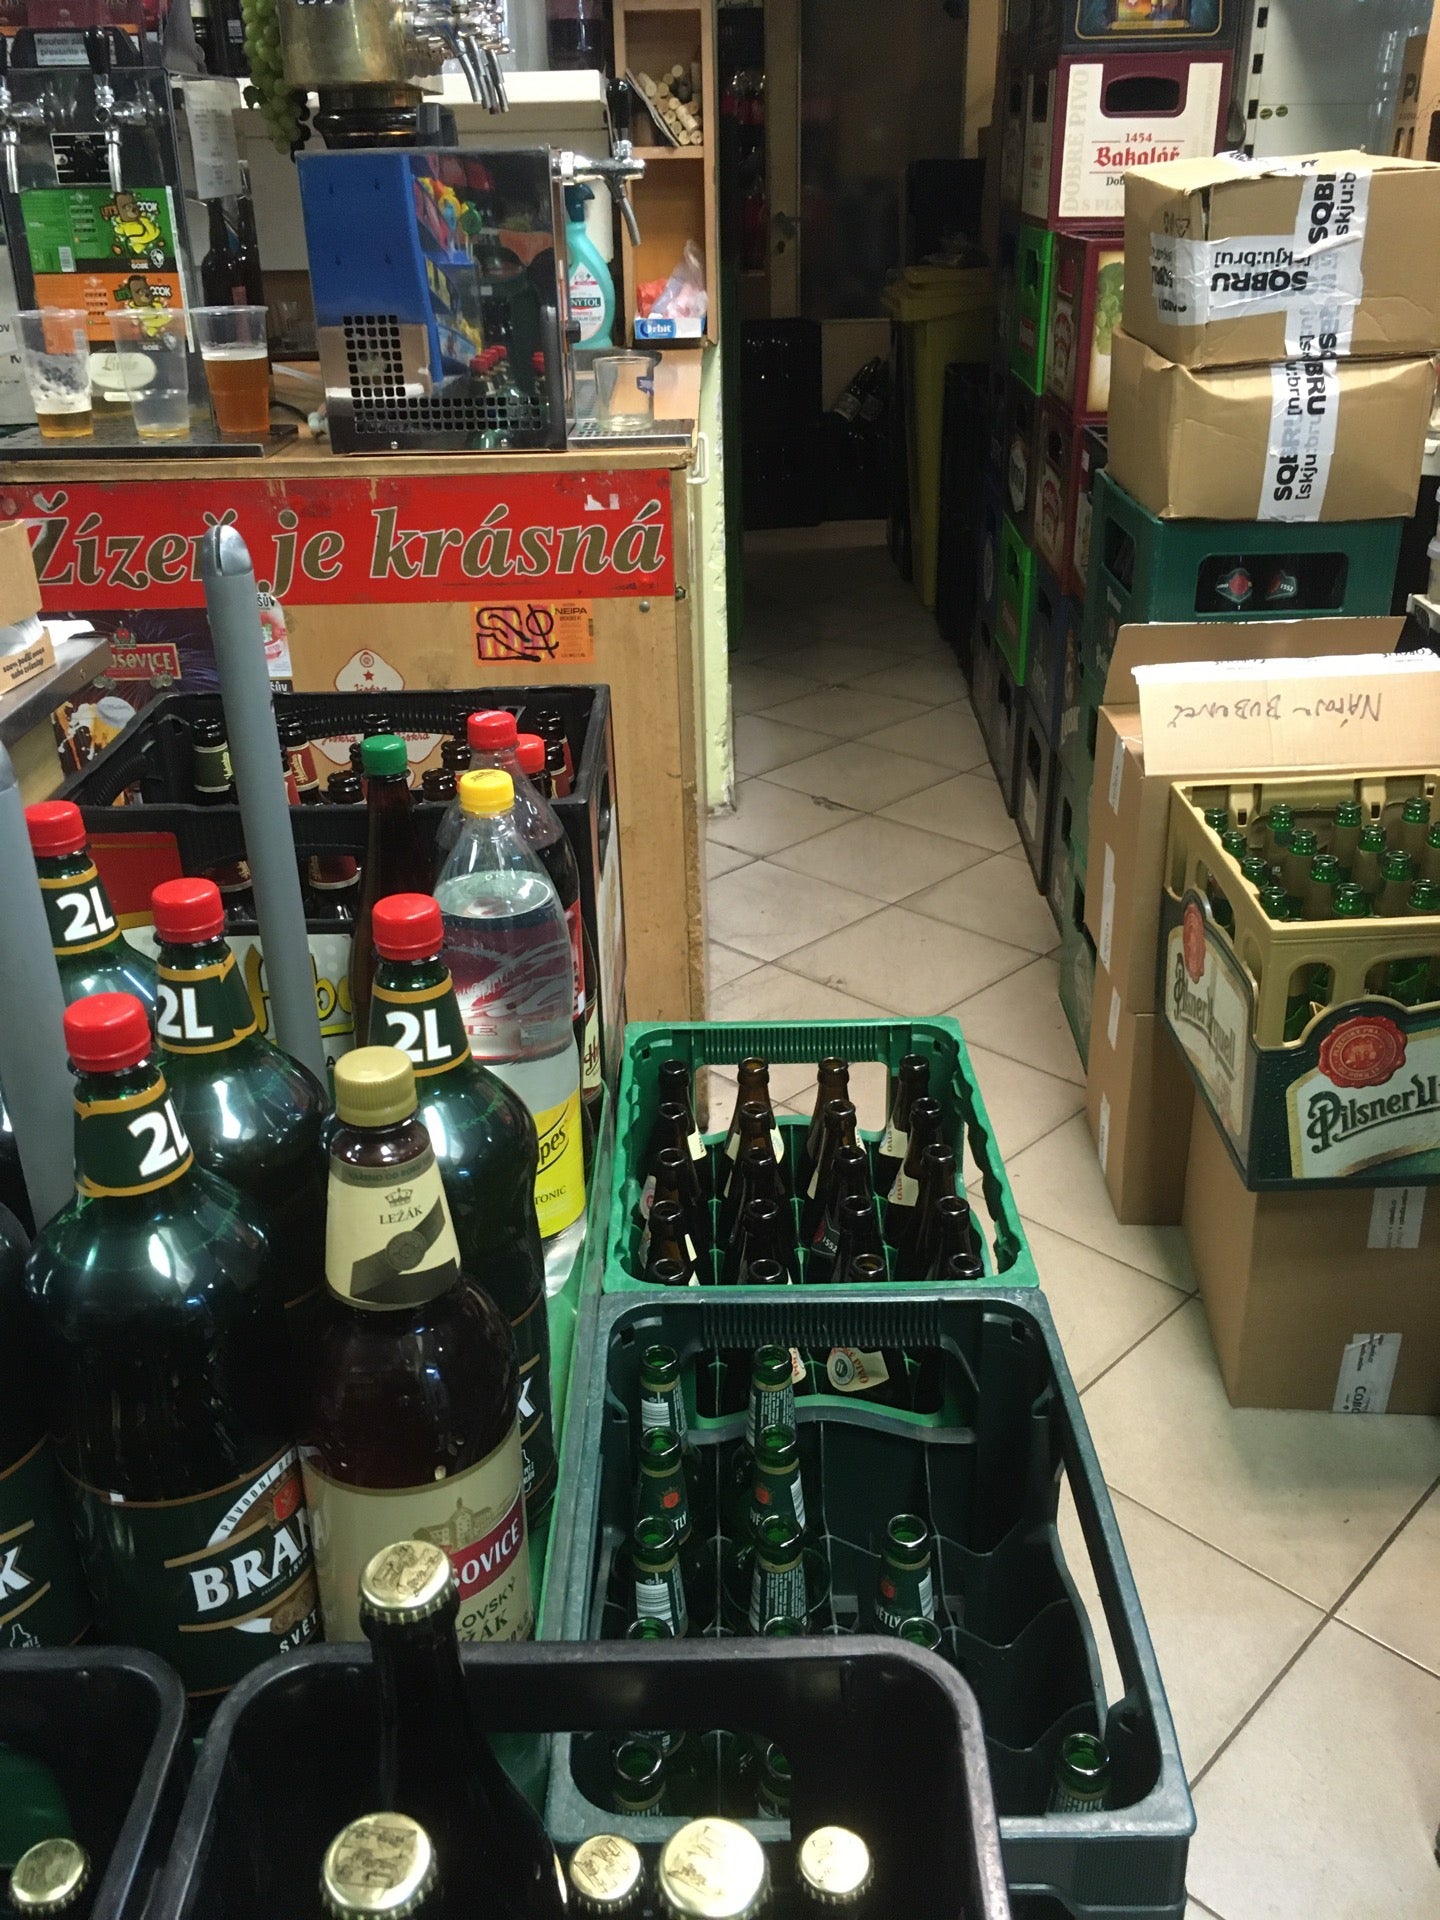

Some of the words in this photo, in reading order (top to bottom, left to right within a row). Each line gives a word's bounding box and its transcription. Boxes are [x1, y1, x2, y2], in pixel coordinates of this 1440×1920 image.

[1125, 132, 1153, 143] 1454
[1093, 146, 1180, 168] Bakalář
[1210, 269, 1309, 292] SQBRU
[571, 298, 600, 308] NYTOL
[256, 509, 345, 599] je
[369, 499, 666, 579] krásná
[554, 607, 588, 615] NEIPA
[56, 885, 115, 942] 2L
[157, 987, 214, 1039] 2L
[385, 1008, 452, 1063] 2L
[1306, 1088, 1416, 1154] Pilsner
[127, 1099, 191, 1178] 2L
[534, 1185, 567, 1205] TONIC
[379, 1205, 424, 1225] LEŽÁK
